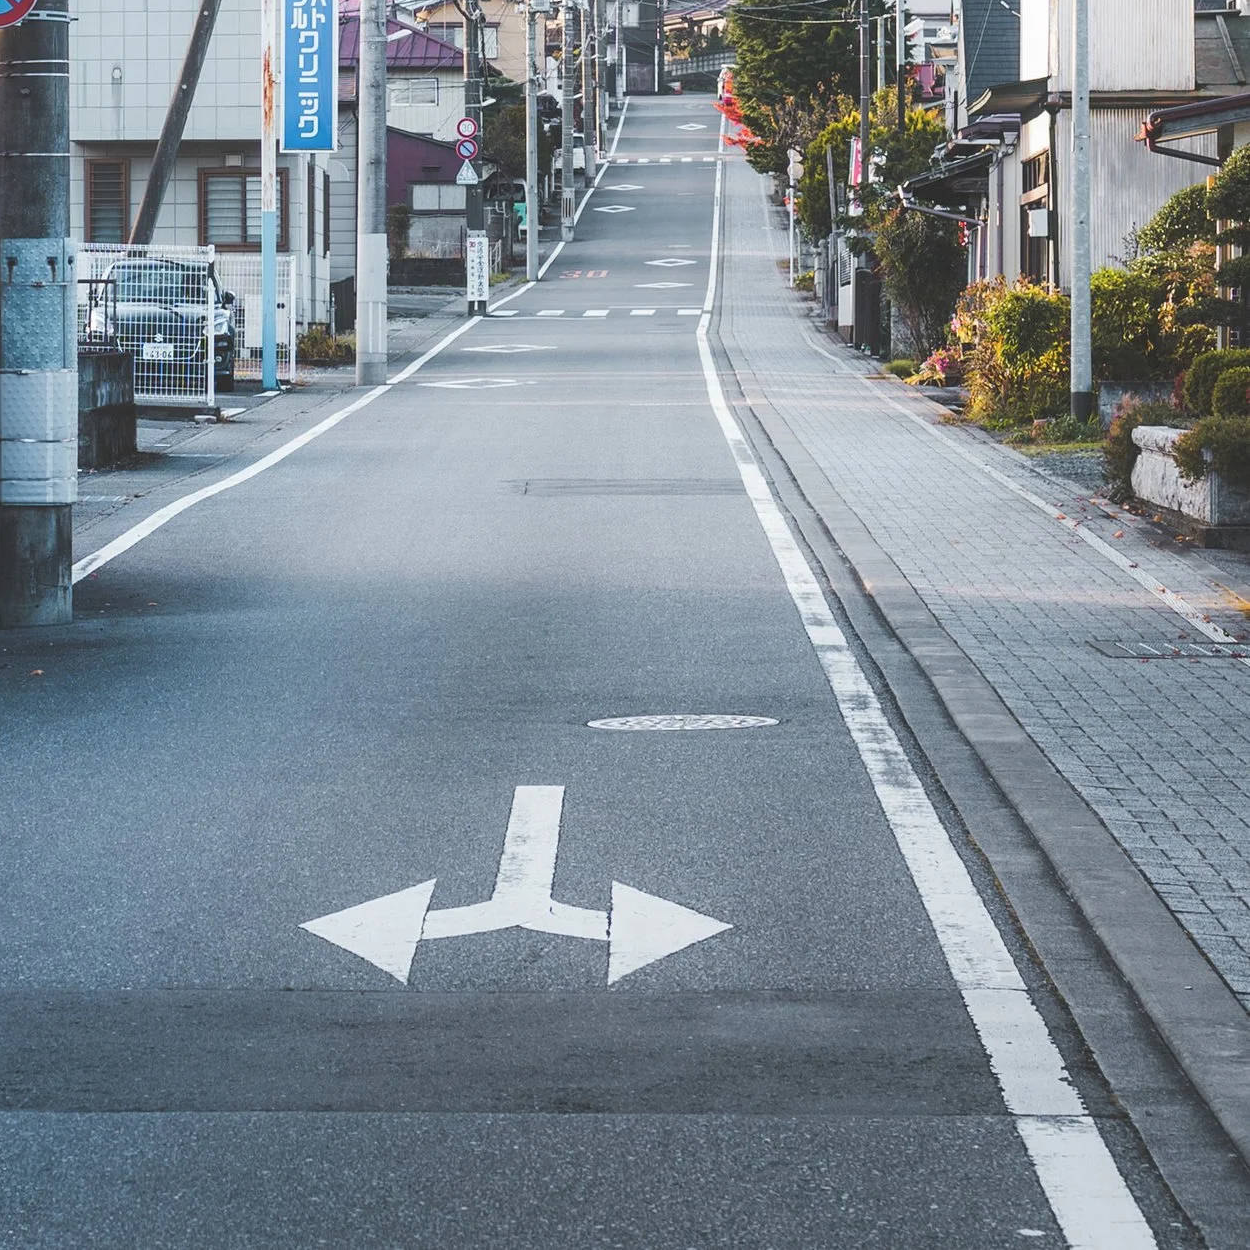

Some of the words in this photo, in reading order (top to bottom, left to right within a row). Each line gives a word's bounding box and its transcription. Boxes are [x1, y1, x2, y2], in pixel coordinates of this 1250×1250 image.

[298, 31, 319, 138] クリニック
[461, 123, 473, 133] 30
[559, 270, 609, 278] 30
